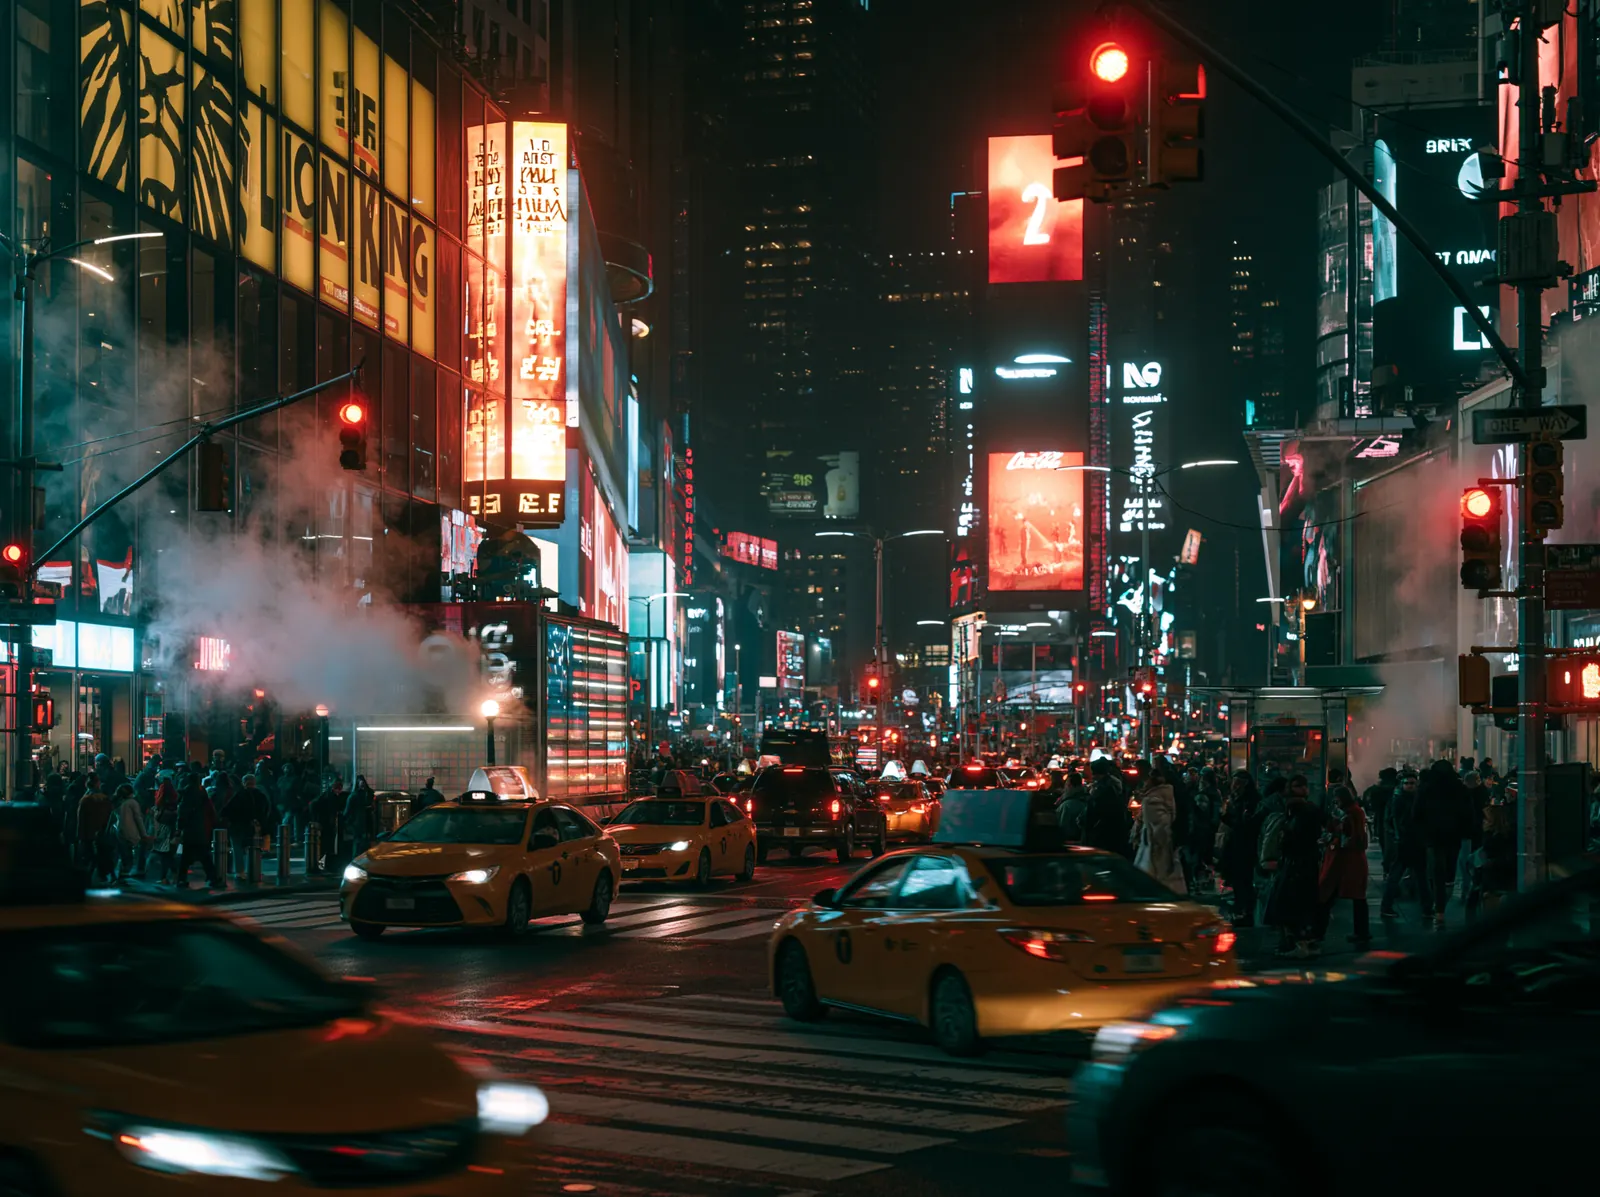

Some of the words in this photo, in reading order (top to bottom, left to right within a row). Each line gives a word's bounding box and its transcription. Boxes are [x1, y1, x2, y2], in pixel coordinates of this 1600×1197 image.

[260, 84, 346, 243] LION
[359, 157, 429, 298] KING
[1021, 181, 1052, 246] 2
[1490, 418, 1520, 432] ONE
[1538, 415, 1570, 431] WAY
